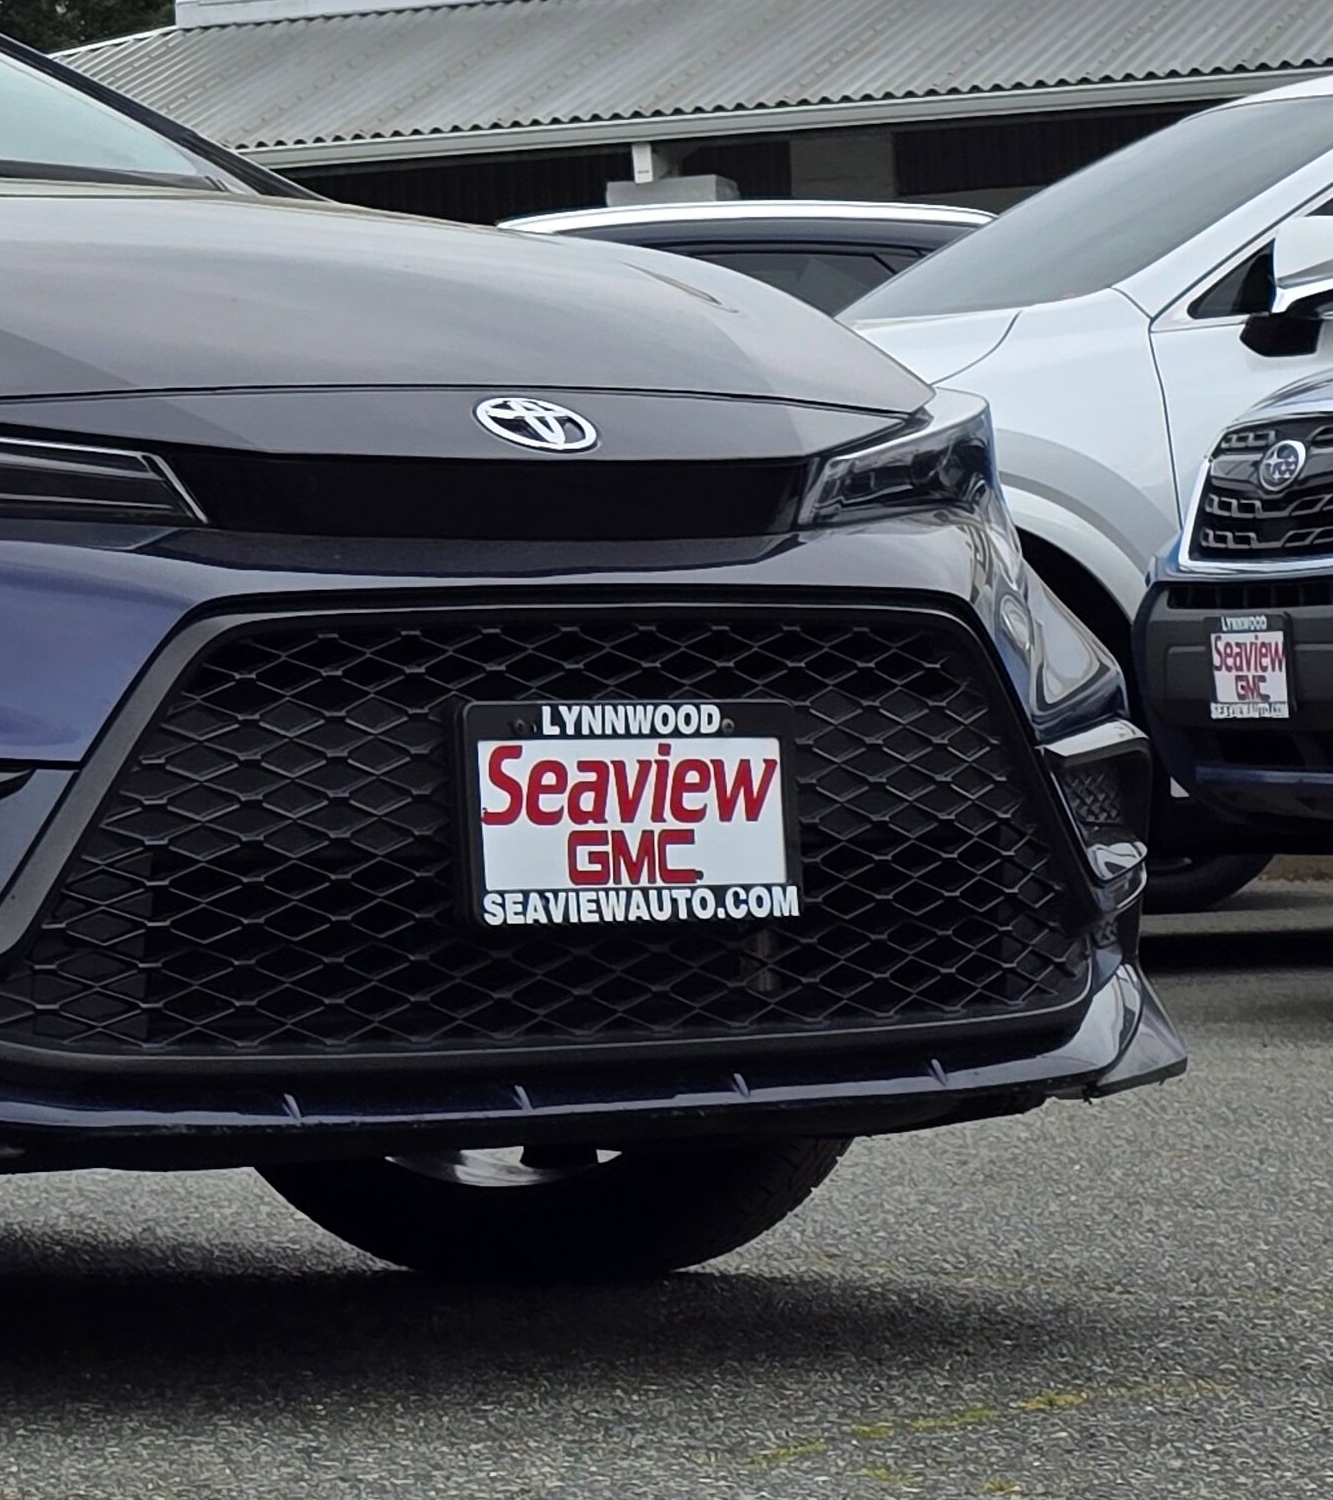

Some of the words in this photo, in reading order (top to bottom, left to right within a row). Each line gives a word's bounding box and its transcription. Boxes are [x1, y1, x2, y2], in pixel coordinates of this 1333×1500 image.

[1213, 634, 1285, 672] Seaview
[1235, 675, 1271, 702] GMC
[541, 704, 721, 735] LYNNWOOD
[481, 743, 778, 825] Seaview
[568, 829, 699, 885] GMC
[483, 885, 800, 926] SEAVIEWAUTO.COM
